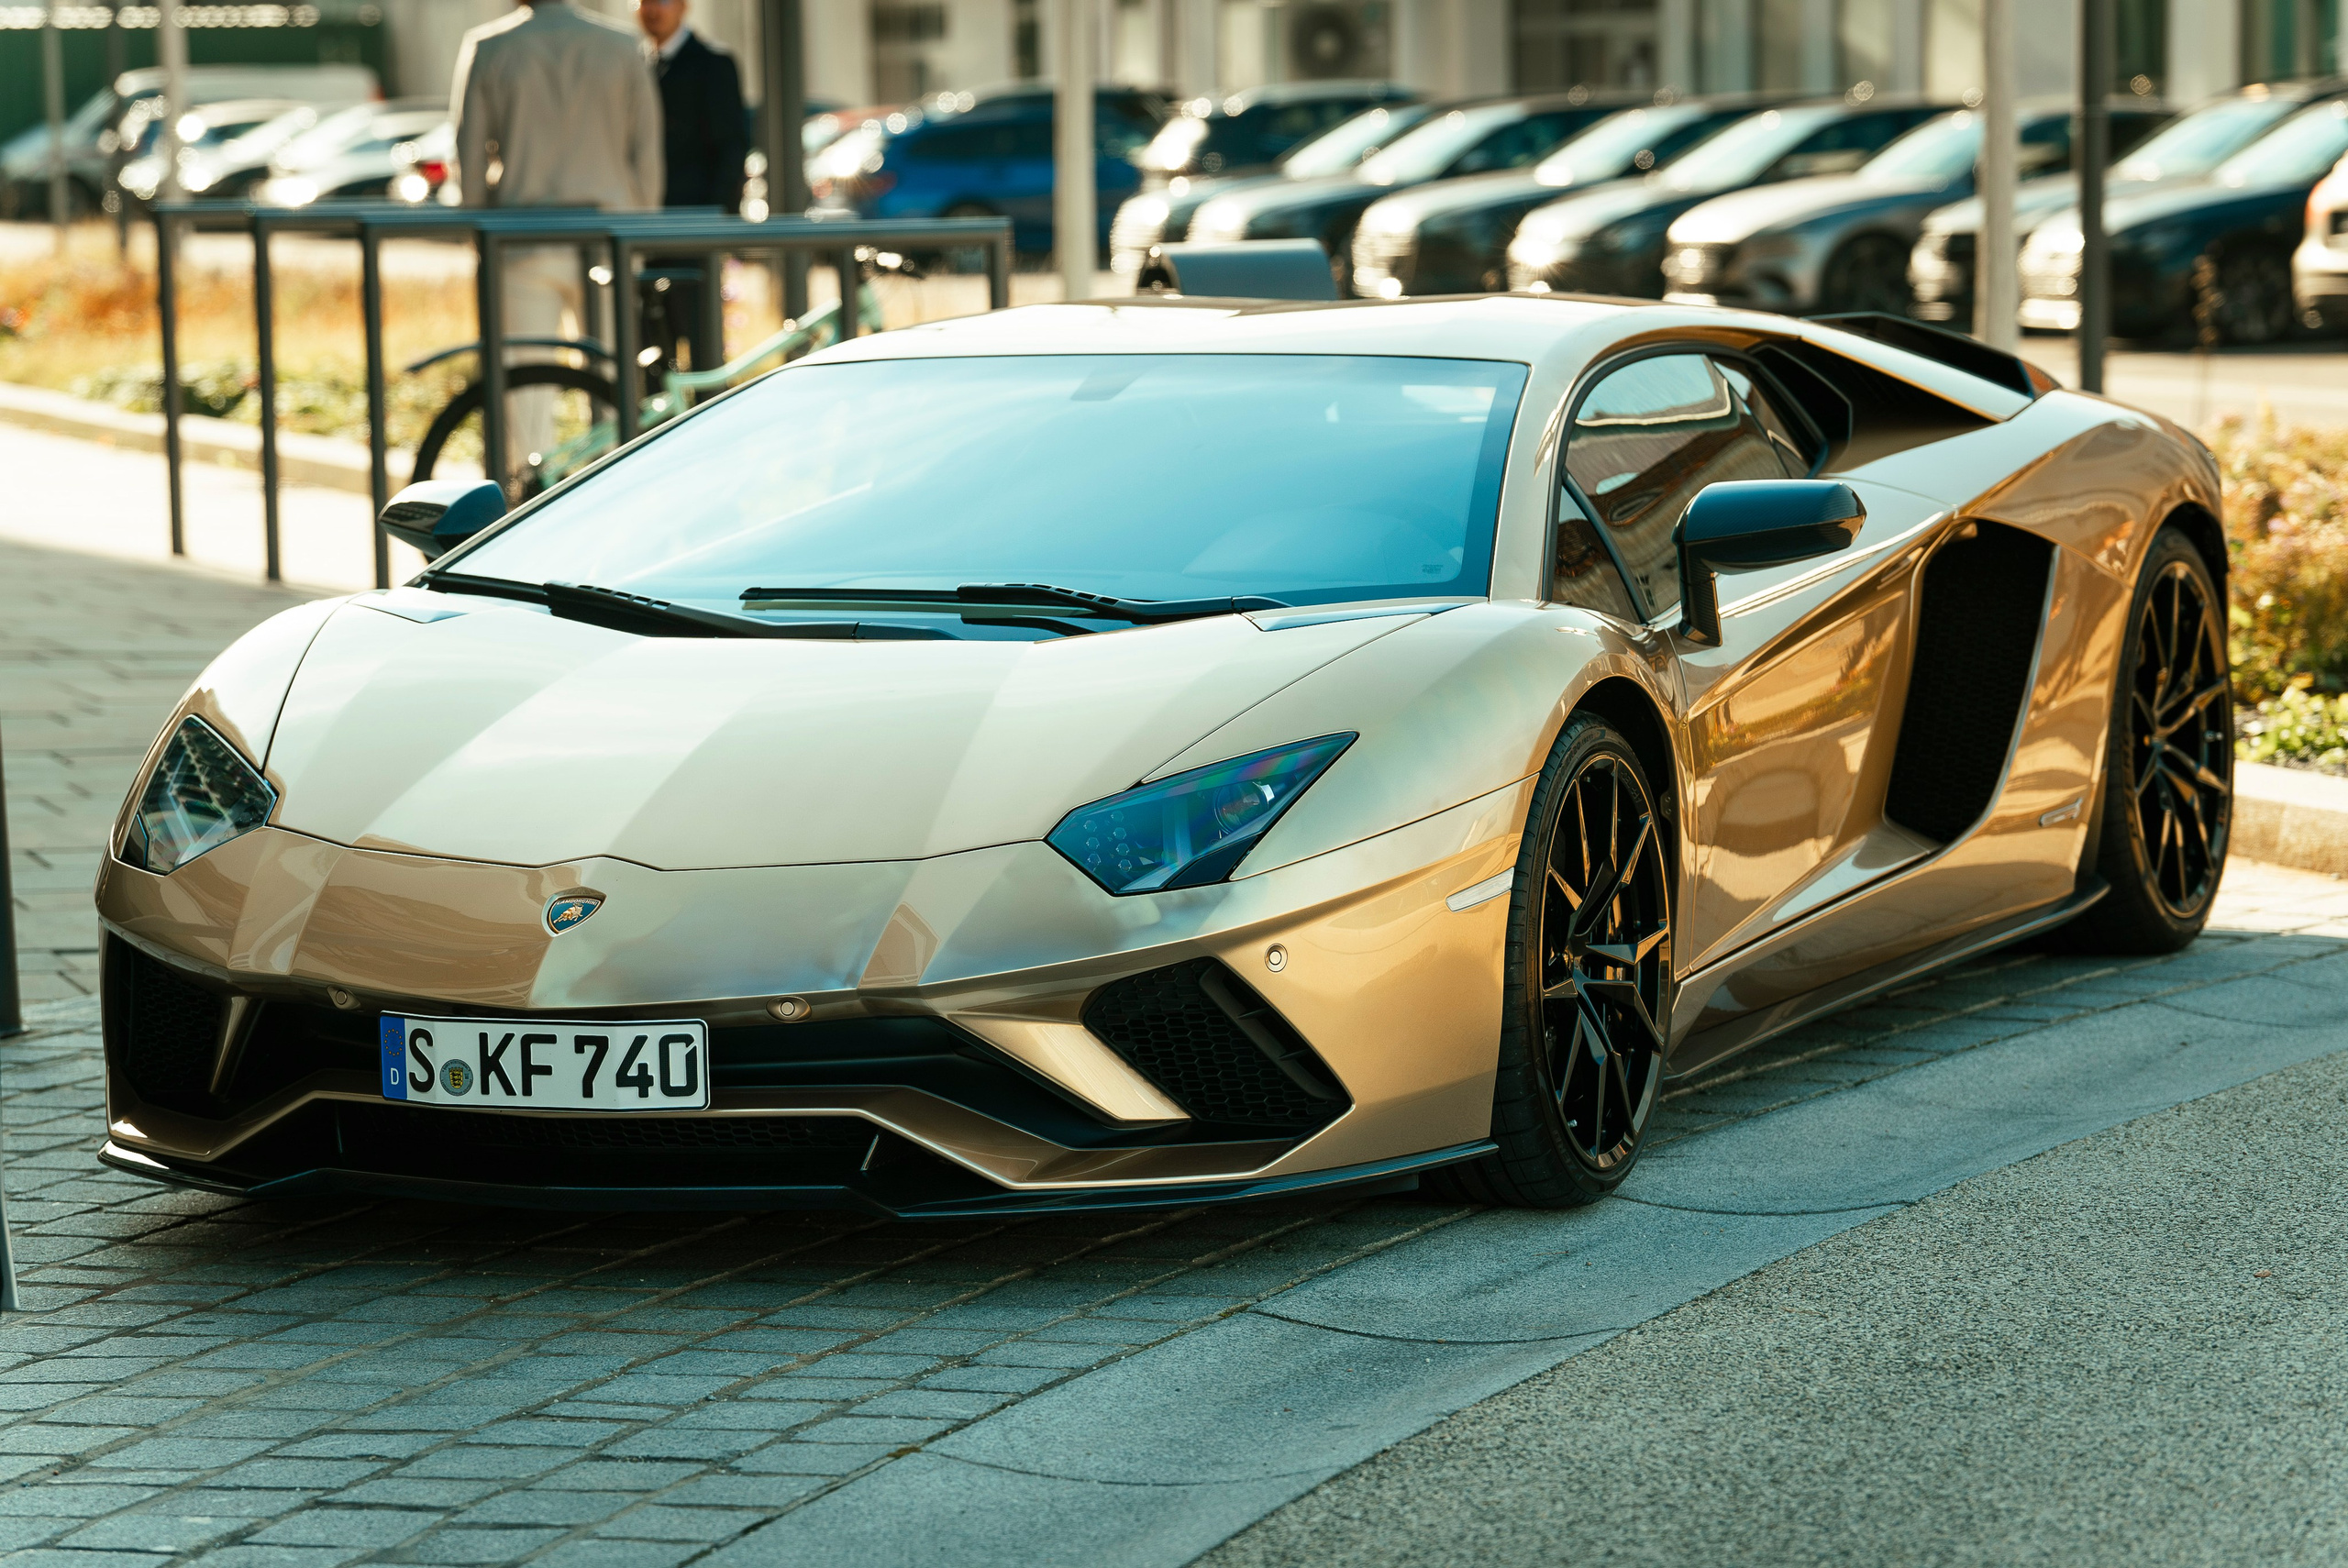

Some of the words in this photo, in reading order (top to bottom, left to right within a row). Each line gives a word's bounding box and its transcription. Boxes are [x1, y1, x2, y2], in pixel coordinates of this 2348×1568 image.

[390, 1067, 399, 1086] D
[409, 1028, 435, 1093] S
[479, 1032, 558, 1097] KF
[574, 1033, 699, 1099] 740
